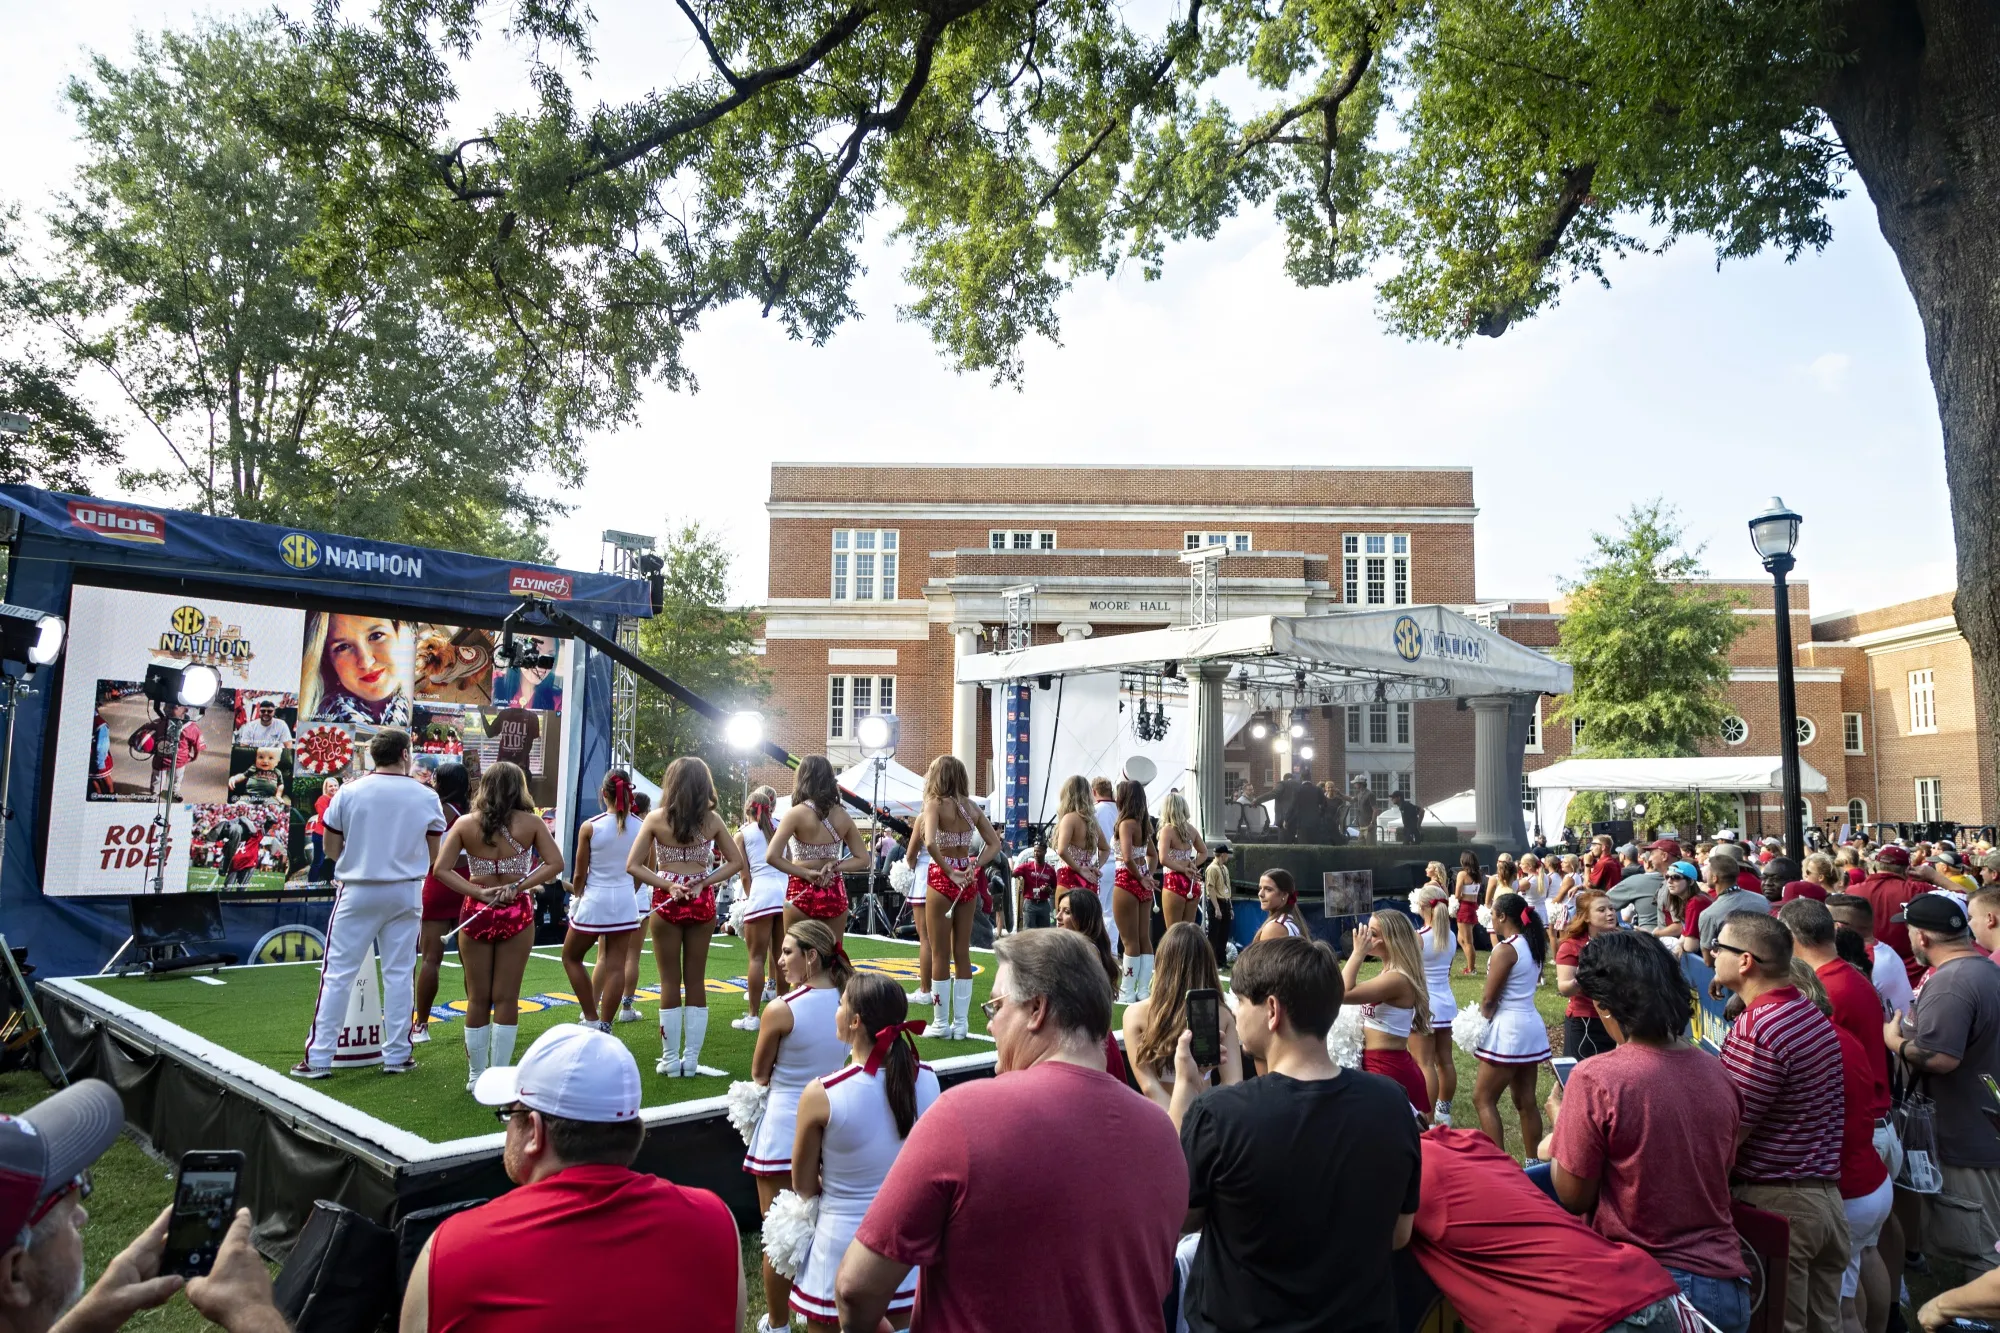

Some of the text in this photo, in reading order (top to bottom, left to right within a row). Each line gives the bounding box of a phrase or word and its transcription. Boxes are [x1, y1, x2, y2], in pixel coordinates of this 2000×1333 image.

[76, 508, 155, 533] Pilot
[281, 534, 422, 578] SEC NATION
[512, 577, 555, 592] FLYING
[1089, 600, 1171, 611] MOORE HALL
[173, 606, 204, 634] SEC
[161, 632, 250, 657] NATION
[1395, 618, 1488, 664] SEC NATION
[501, 720, 527, 735] ROLL
[309, 732, 342, 750] Roll
[311, 745, 344, 761] Tide
